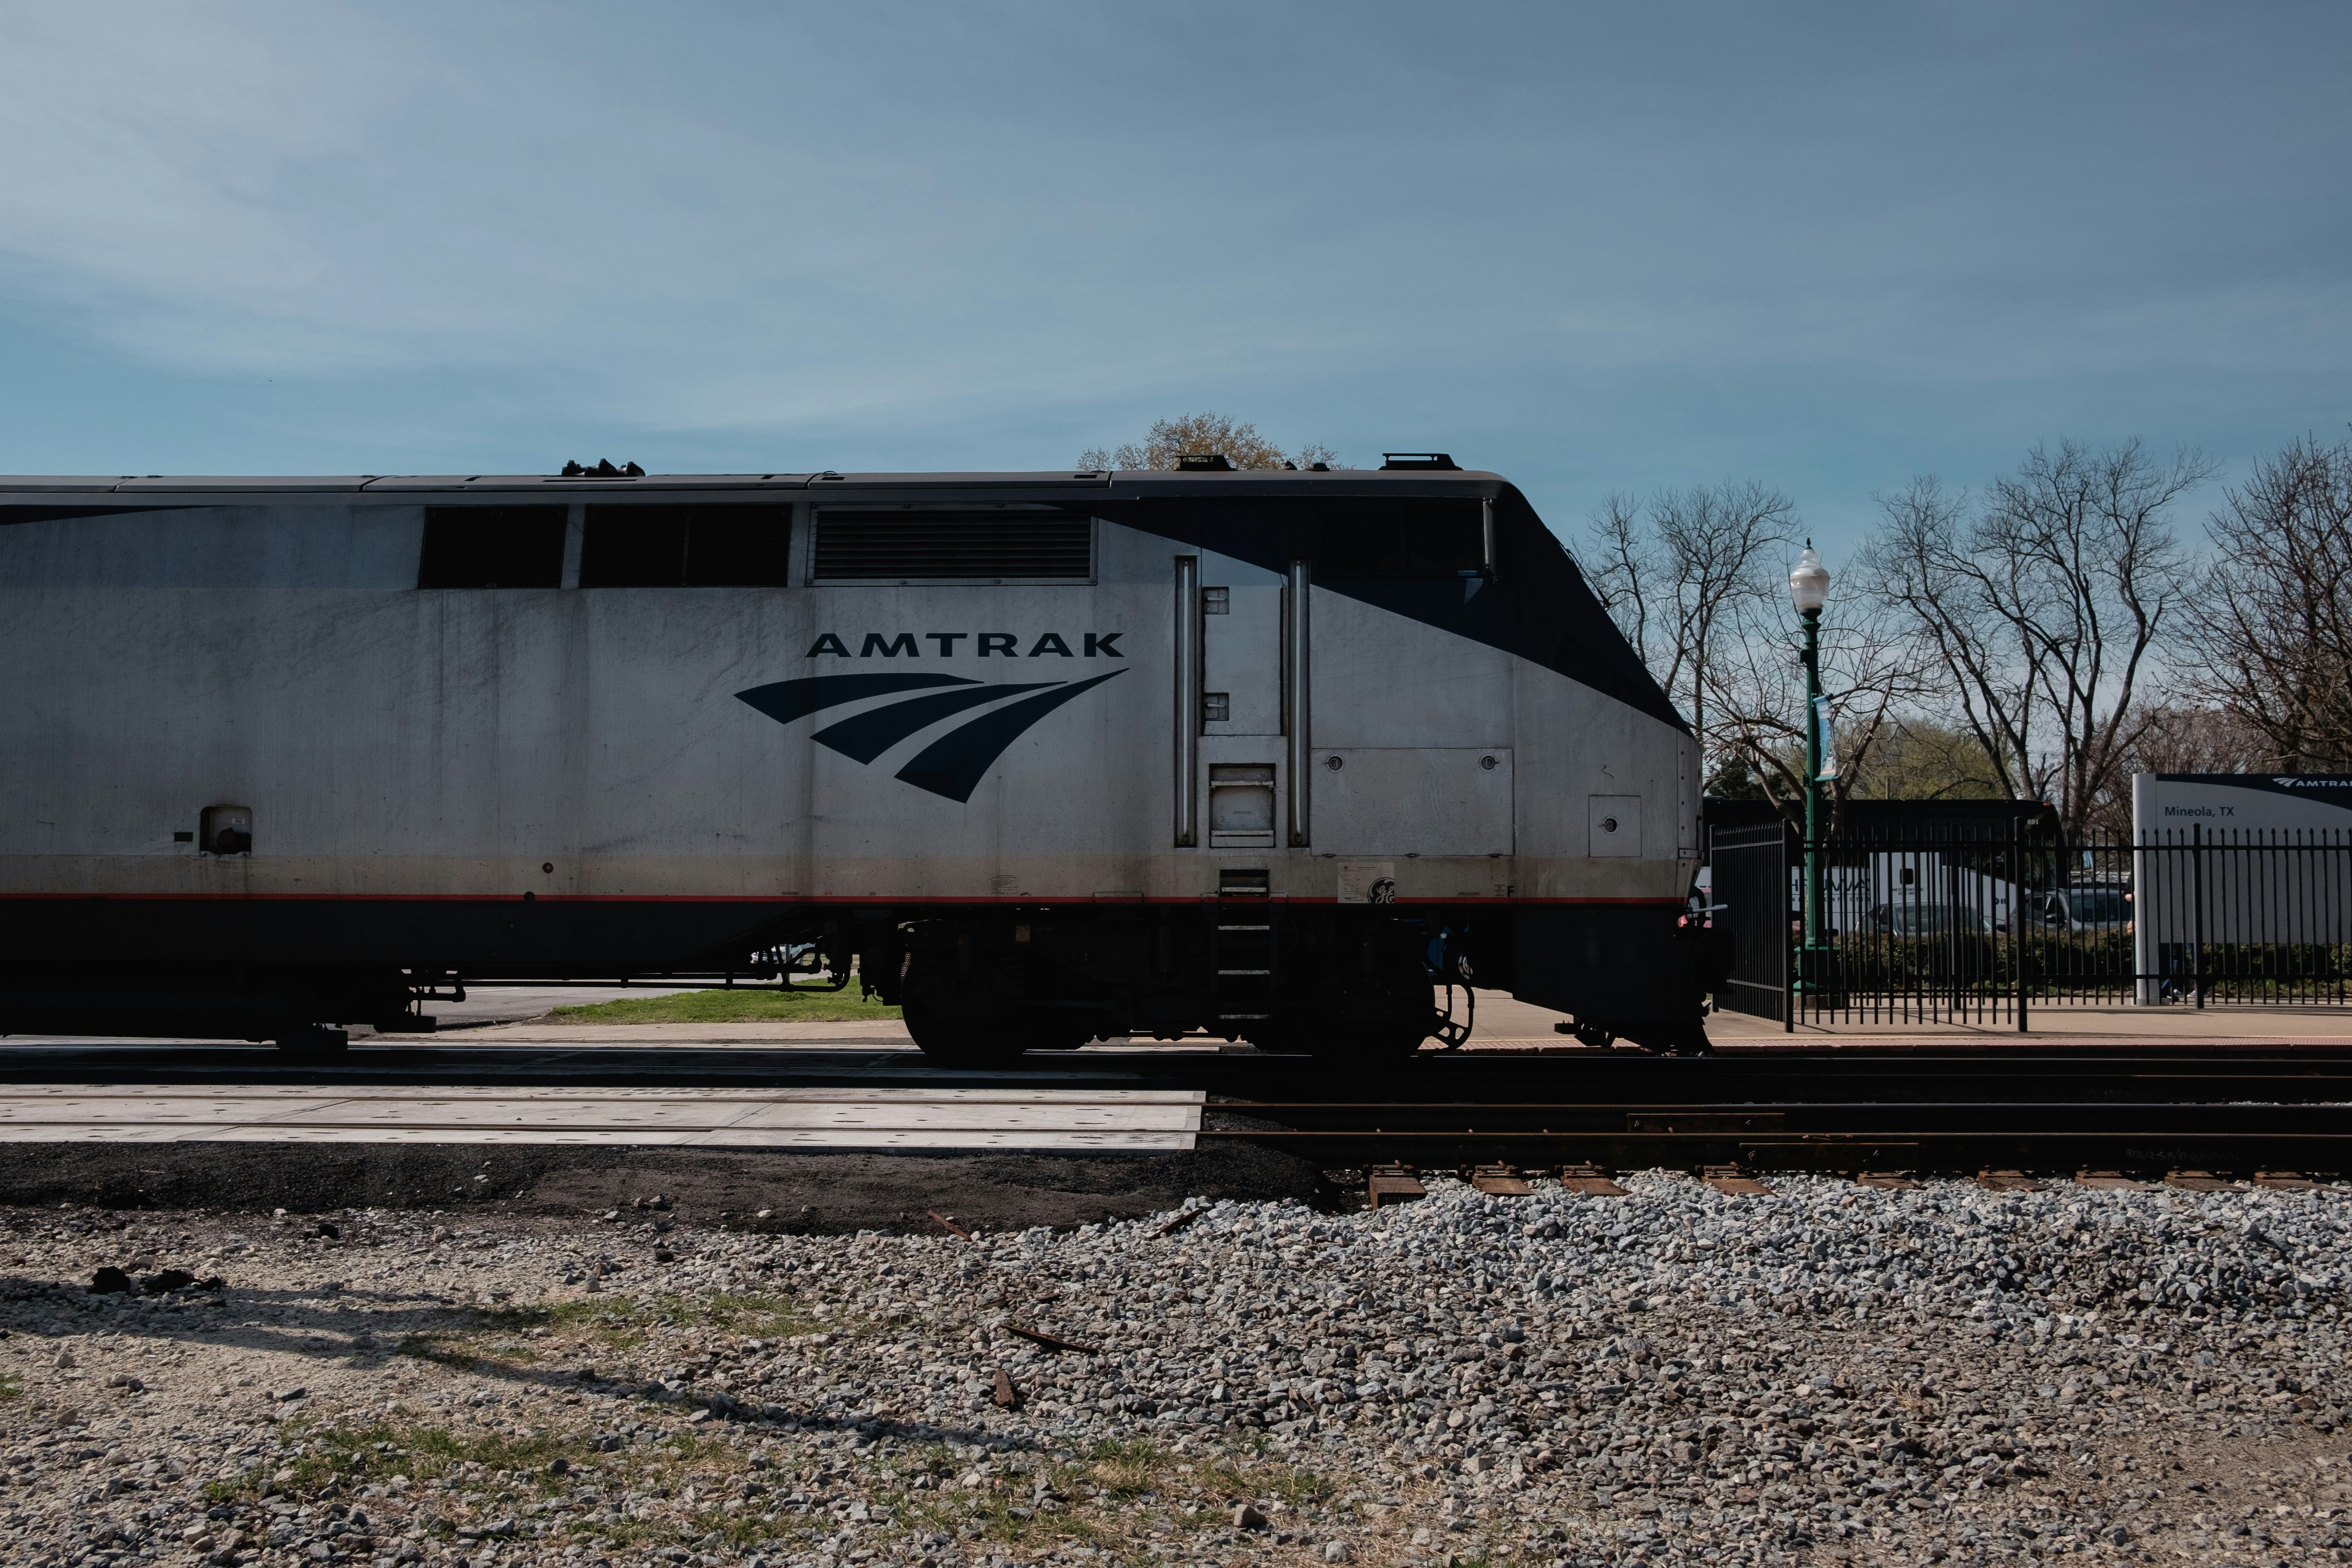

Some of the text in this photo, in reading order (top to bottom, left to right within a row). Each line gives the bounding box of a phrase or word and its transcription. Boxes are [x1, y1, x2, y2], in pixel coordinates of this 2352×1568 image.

[805, 633, 1126, 658] AMTRAK
[2165, 806, 2234, 817] Mineola, TX
[1507, 885, 1515, 897] F
